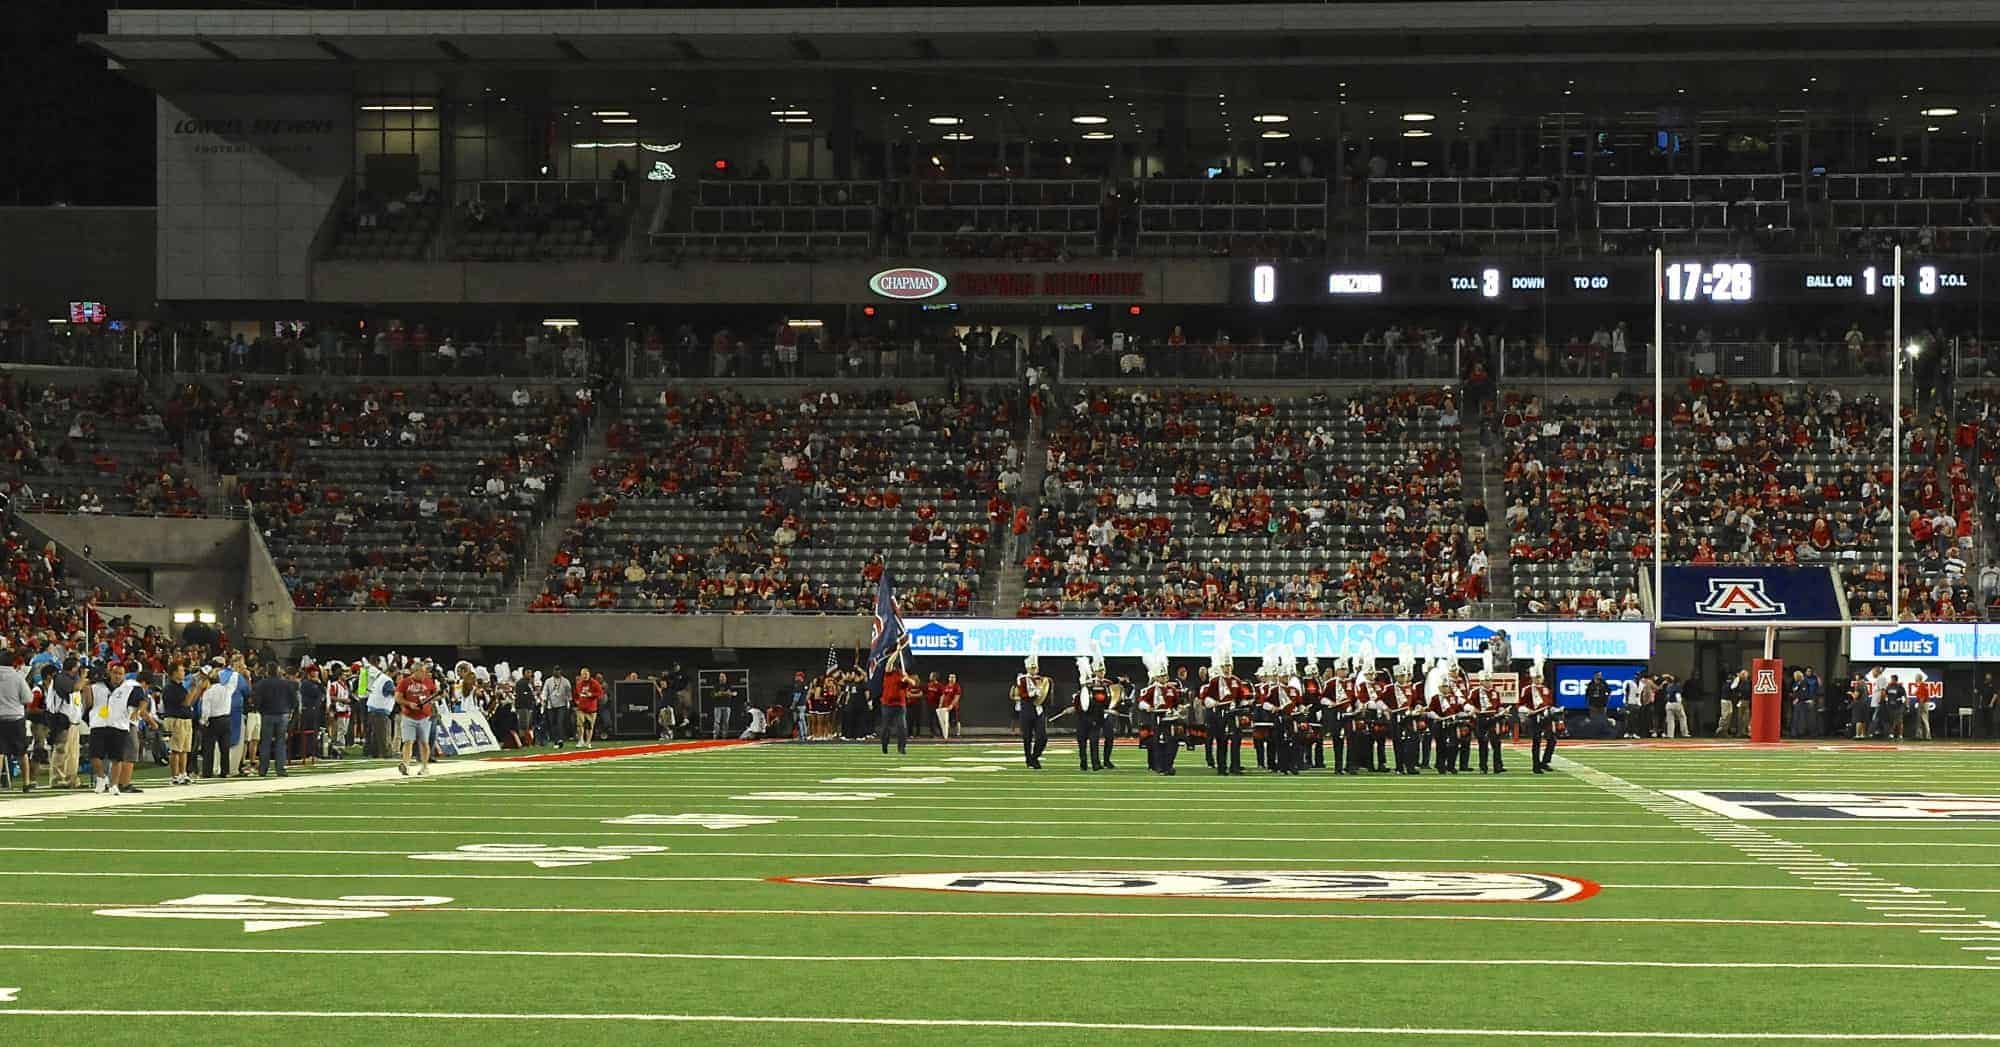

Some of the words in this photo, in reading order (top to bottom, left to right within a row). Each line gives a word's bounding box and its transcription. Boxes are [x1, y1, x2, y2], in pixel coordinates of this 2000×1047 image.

[880, 276, 934, 290] CHAPMAN
[1511, 277, 1545, 289] DOWN
[1573, 277, 1590, 289] TO
[1591, 277, 1609, 289] GO
[1666, 263, 1752, 300] 17:28
[1806, 275, 1835, 287] BALL
[1835, 275, 1853, 287] ON
[1863, 267, 1876, 296] 1
[908, 632, 960, 649] LOWE'S
[1090, 622, 1217, 653] GAME
[1229, 623, 1434, 655] SPONSOR
[1880, 637, 1934, 654] LOWE'S
